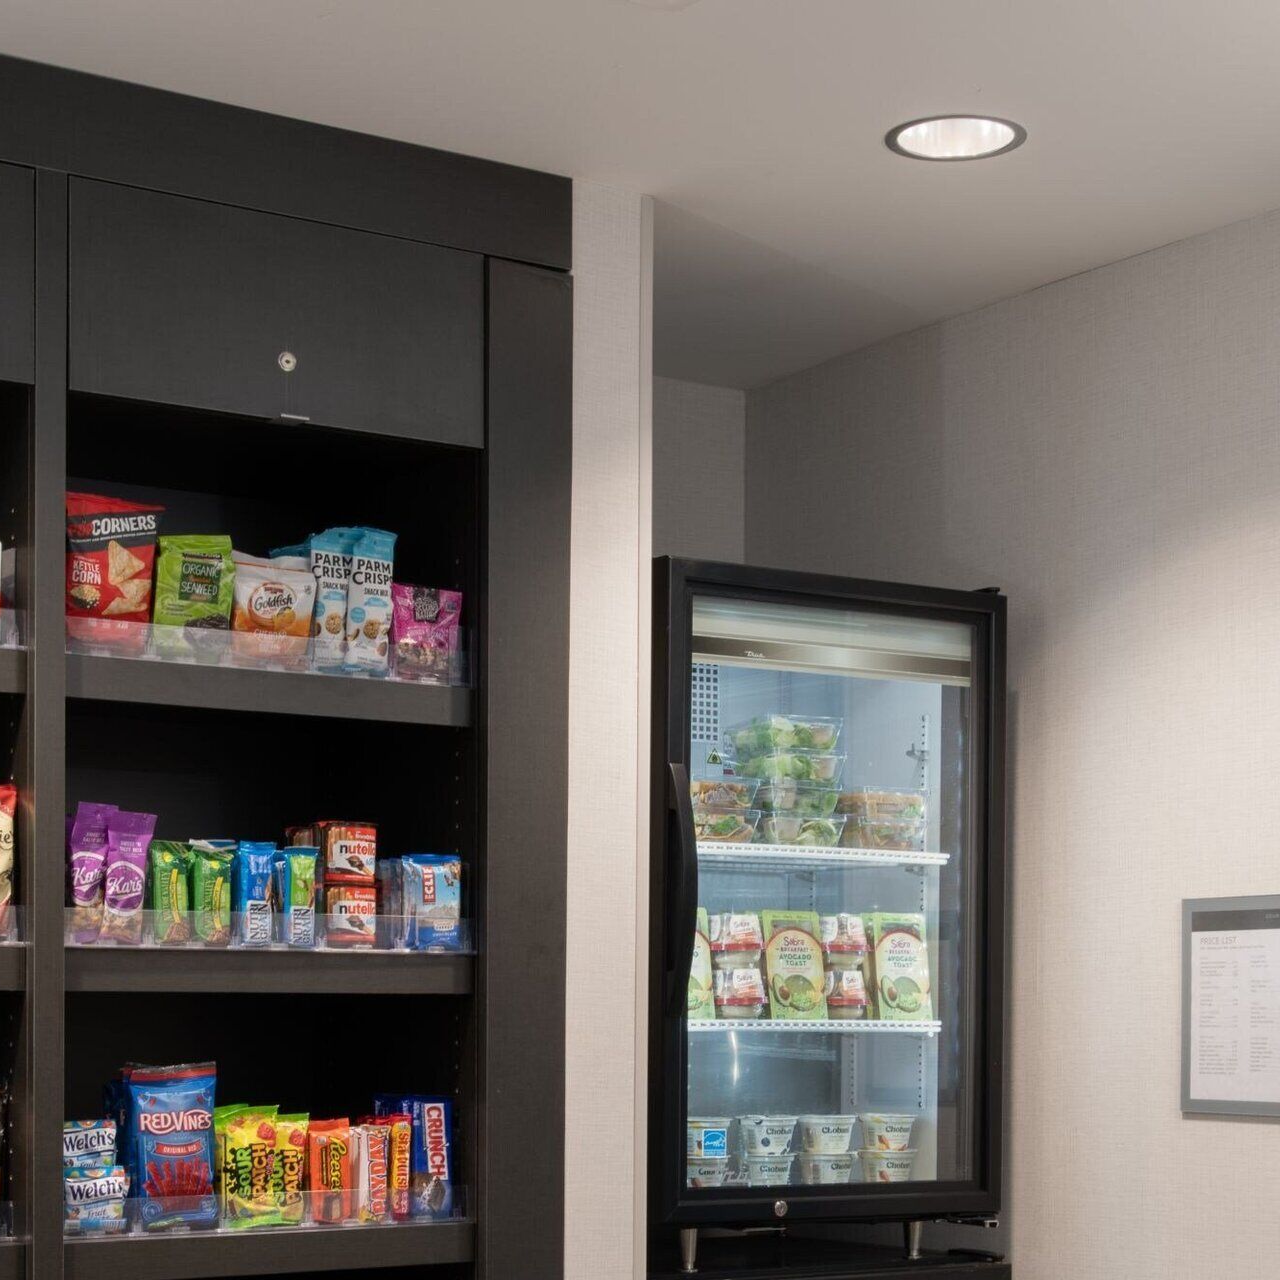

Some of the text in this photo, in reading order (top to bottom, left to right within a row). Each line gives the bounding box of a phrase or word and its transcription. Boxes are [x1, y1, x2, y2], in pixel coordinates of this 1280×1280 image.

[92, 515, 156, 536] CORNERS
[72, 560, 100, 572] KETTLE
[182, 563, 219, 576] ORGANIC
[314, 552, 353, 567] PARM
[357, 560, 391, 573] PARM
[72, 571, 101, 584] CORN
[312, 565, 351, 580] CRISP
[181, 581, 218, 596] SEAWEED
[322, 581, 340, 590] SNACK
[364, 587, 389, 596] SNACK MIX
[254, 594, 293, 611] Goldfish
[249, 904, 260, 940] NUTRI
[258, 904, 269, 940] GRAIN
[292, 908, 304, 944] NUTRI
[301, 909, 311, 944] GRAIN
[783, 936, 805, 947] Sabra
[1200, 936, 1237, 945] PRICE LIST
[172, 1110, 212, 1131] VINES
[65, 1132, 115, 1152] Welch's
[426, 1105, 445, 1178] CRUNCH
[251, 1142, 267, 1202] PATCH
[328, 1136, 348, 1194] Reese's
[397, 1132, 410, 1191] Starburst
[236, 1147, 252, 1199] SOUR
[272, 1154, 284, 1203] SOUR
[284, 1150, 299, 1204] PATCH
[368, 1134, 388, 1215] PAYDAY
[70, 1180, 123, 1201] Welch's
[87, 1209, 107, 1217] Fruit
